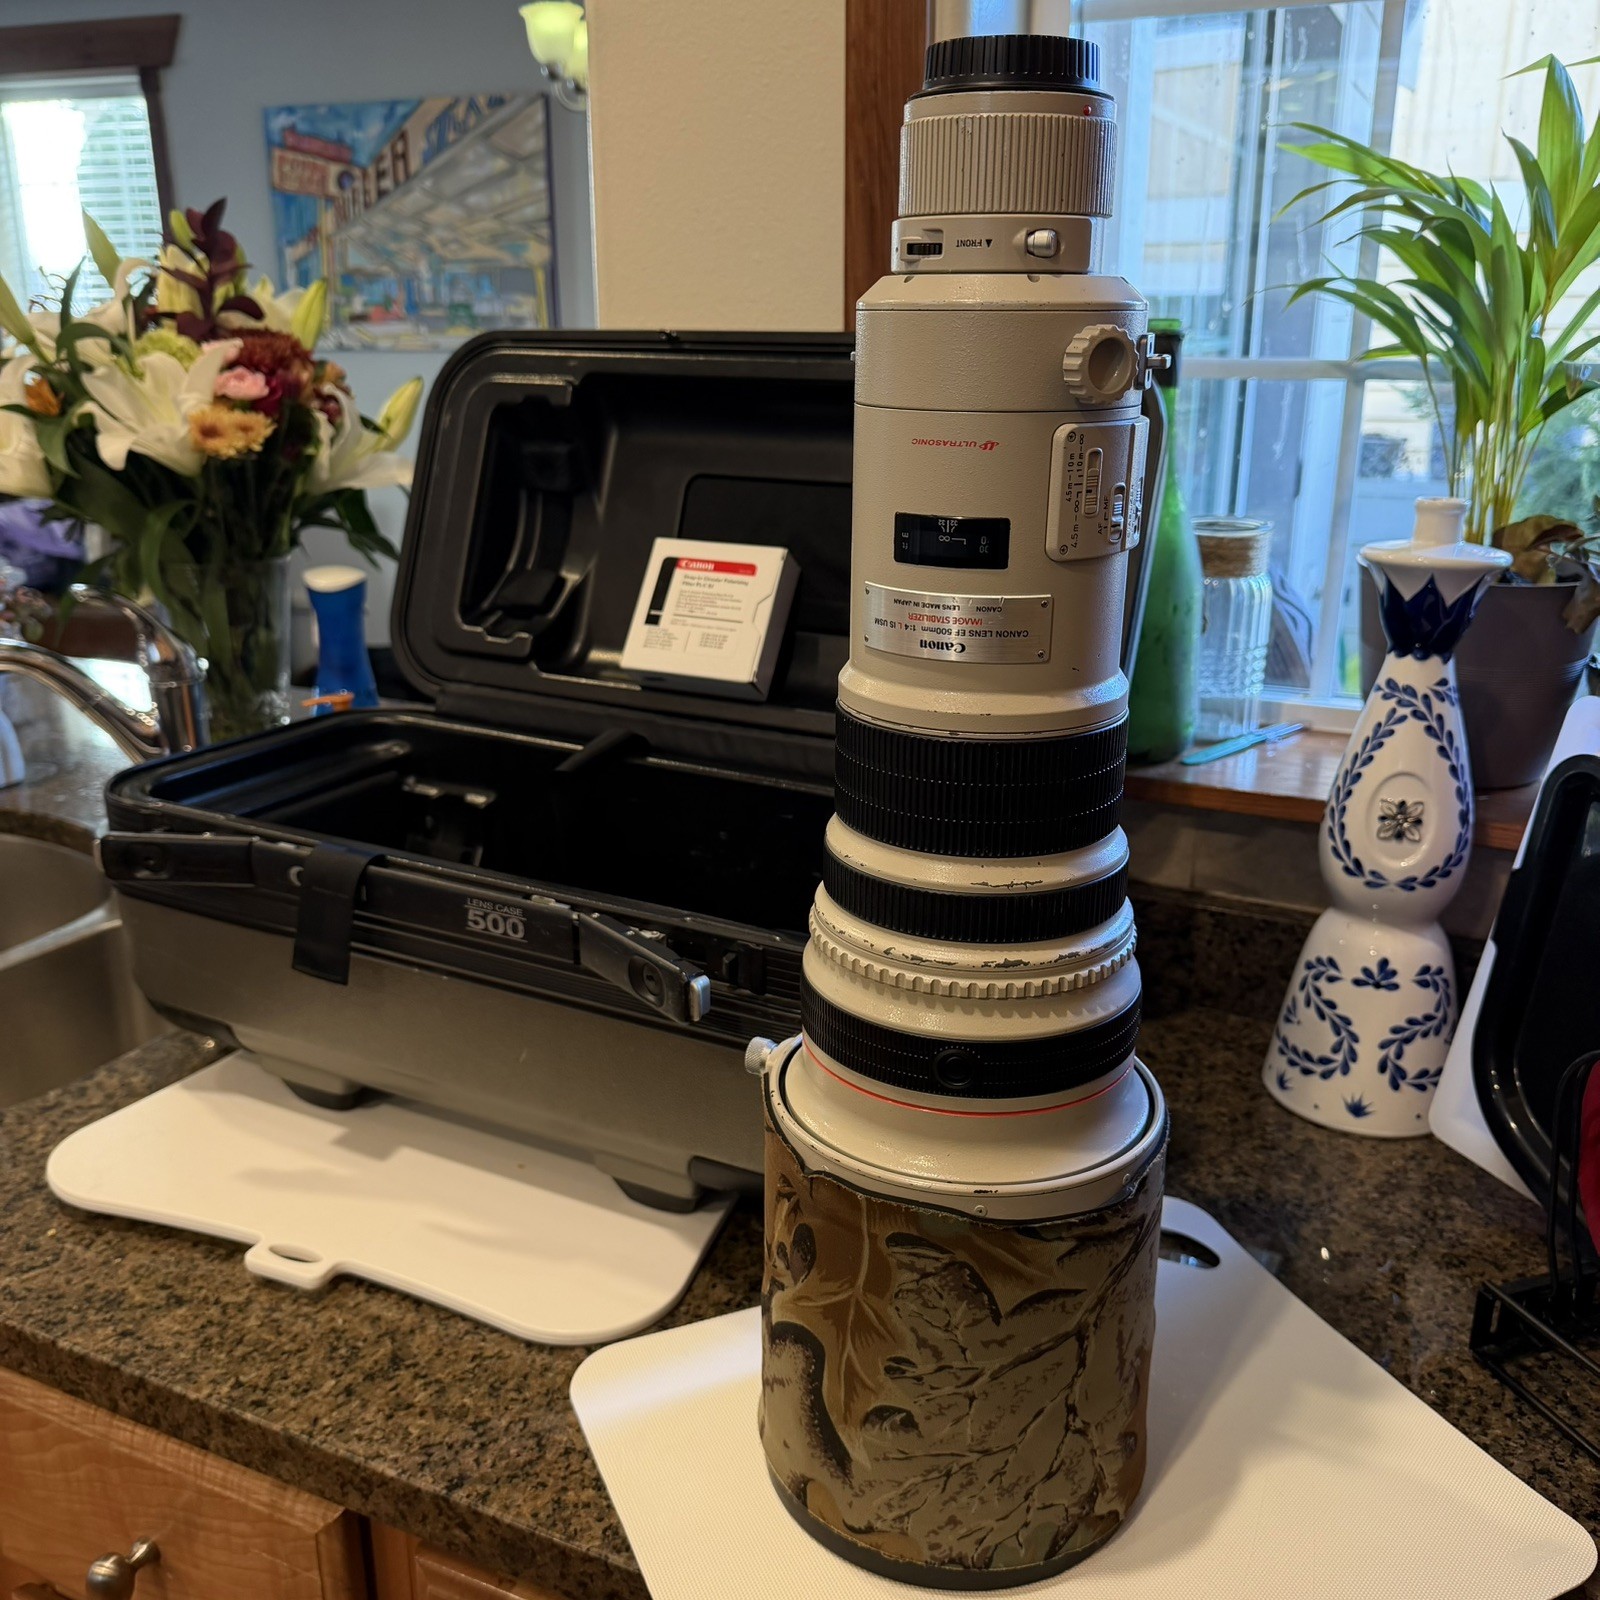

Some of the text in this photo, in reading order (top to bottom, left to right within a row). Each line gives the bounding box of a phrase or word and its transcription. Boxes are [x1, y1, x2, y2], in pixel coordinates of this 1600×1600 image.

[956, 239, 982, 247] FRONT
[911, 438, 977, 448] ULTRASONIC
[681, 560, 715, 571] Canon
[893, 598, 913, 607] JAPAN
[920, 602, 941, 610] MADE
[941, 603, 961, 612] LENS
[975, 605, 1003, 613] CANON
[907, 612, 983, 626] IMAGE STABILIZER
[873, 617, 1029, 638] CANON LENS EF 500mm 1:4 L IS USM
[919, 639, 966, 653] Canon
[466, 897, 524, 917] LENS CASE
[467, 909, 525, 939] 500
